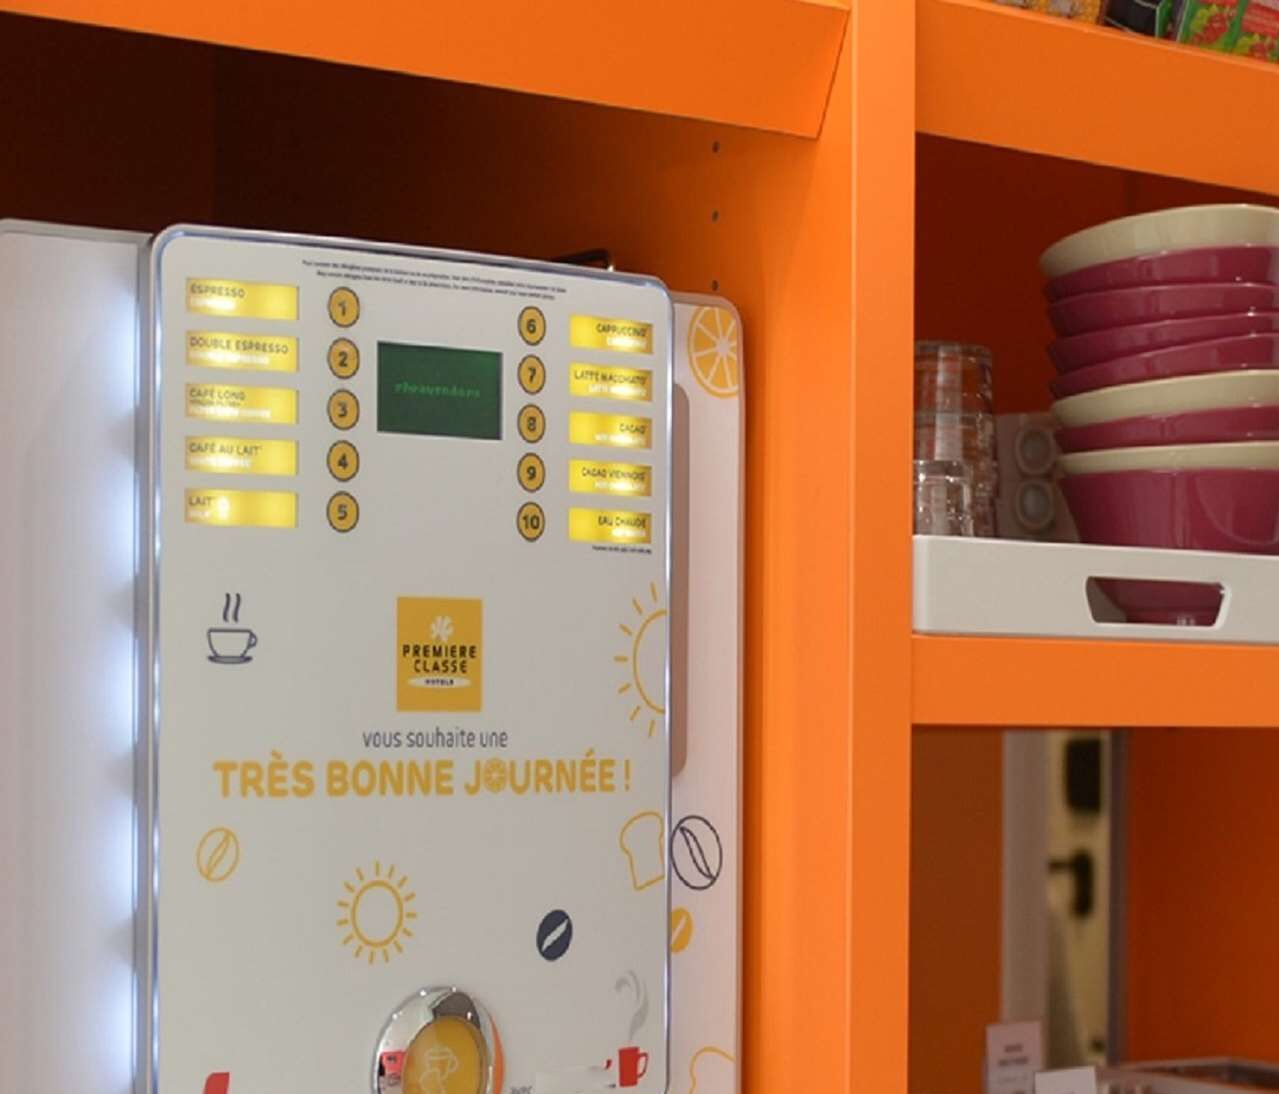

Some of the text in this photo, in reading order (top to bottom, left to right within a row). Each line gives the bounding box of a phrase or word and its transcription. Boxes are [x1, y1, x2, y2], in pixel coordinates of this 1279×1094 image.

[190, 283, 246, 299] ESPRESSO
[337, 301, 347, 317] 1
[526, 319, 537, 334] 6
[189, 336, 289, 355] DOUBLE ESPRESSO
[337, 351, 349, 367] 2
[527, 367, 537, 383] 7
[337, 401, 348, 418] 3
[526, 416, 537, 432] 8
[219, 443, 235, 454] AU
[337, 453, 349, 470] 4
[526, 466, 537, 481] 9
[337, 504, 348, 521] 5
[522, 514, 540, 530] 10
[402, 644, 477, 659] PREMIERE
[414, 659, 468, 674] CLASSE
[363, 725, 509, 748] vous souhaite une
[212, 750, 316, 798] TRÈS
[325, 759, 454, 798] BONNE
[463, 747, 617, 796] JOURNÉE
